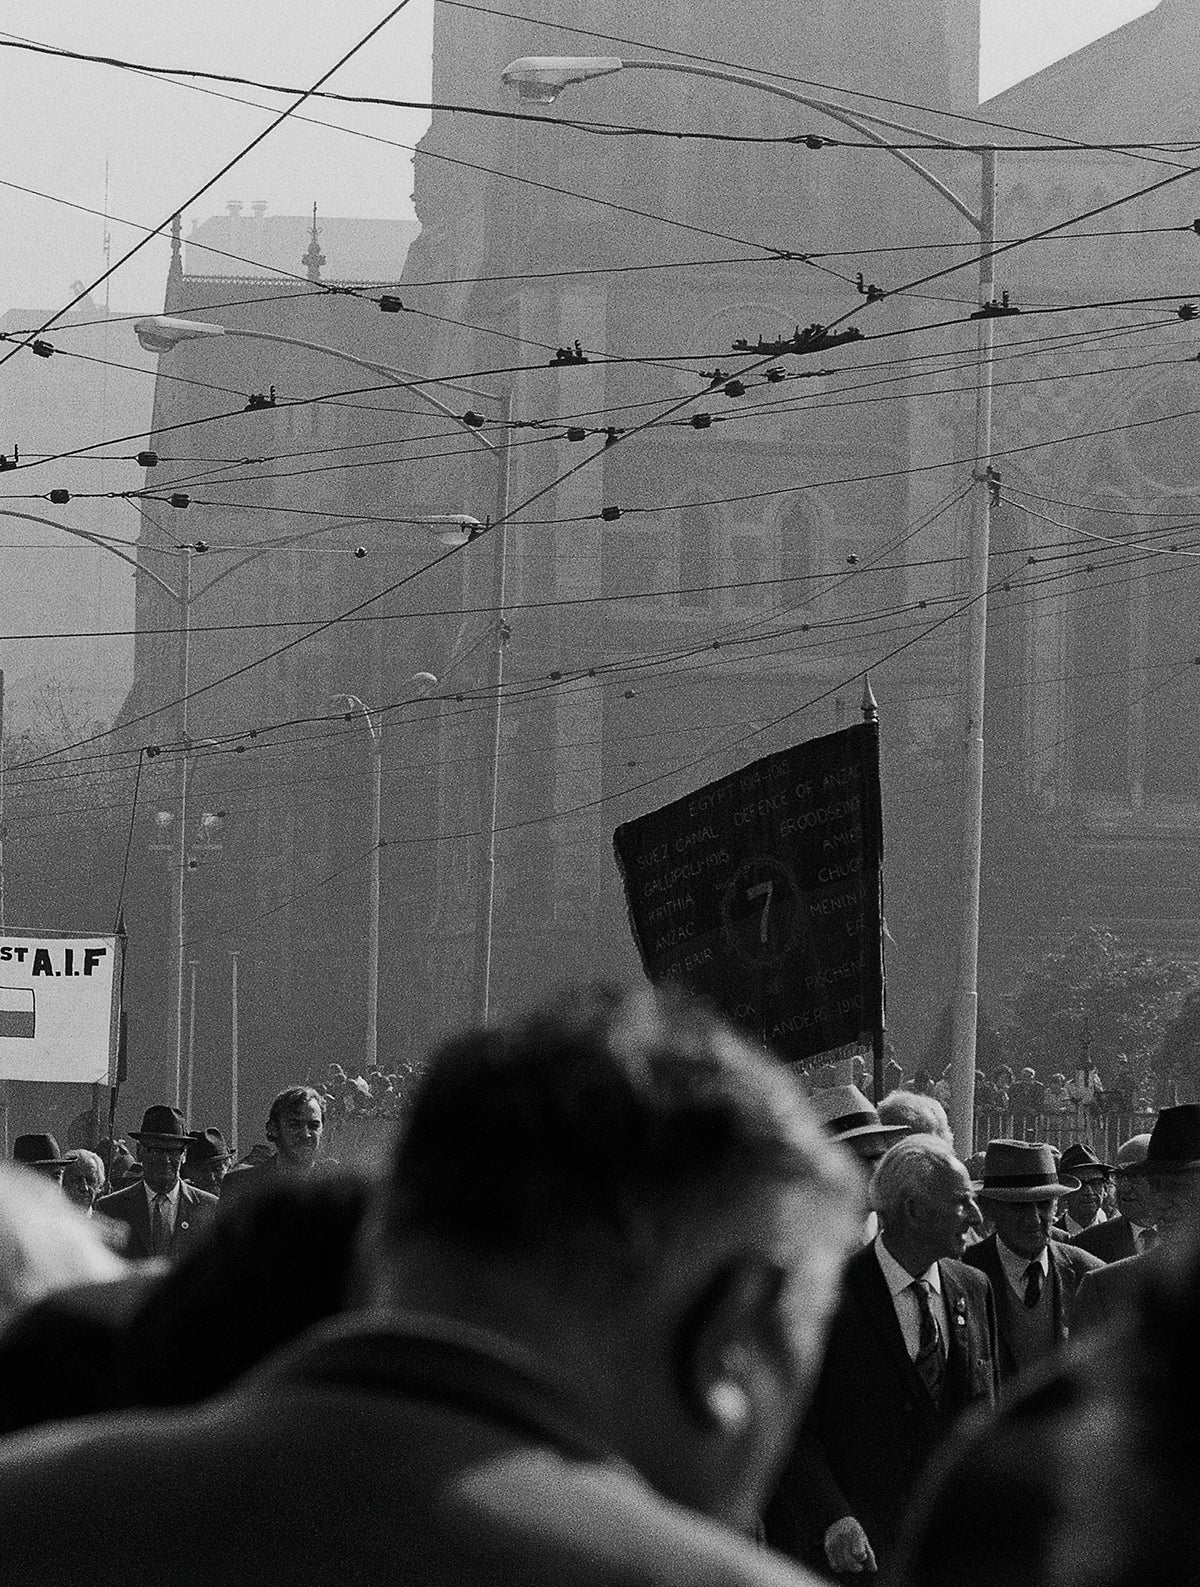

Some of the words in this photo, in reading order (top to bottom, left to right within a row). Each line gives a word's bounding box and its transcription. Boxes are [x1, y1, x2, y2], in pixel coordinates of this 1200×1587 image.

[688, 783, 733, 818] EGYPT
[637, 843, 668, 870] SUEZ
[675, 825, 719, 853] CANAL
[733, 789, 788, 827] DEFENCE
[795, 780, 813, 799] OF
[746, 880, 773, 943] 7
[655, 921, 696, 954] ANZAC
[31, 947, 107, 977] A.I.F
